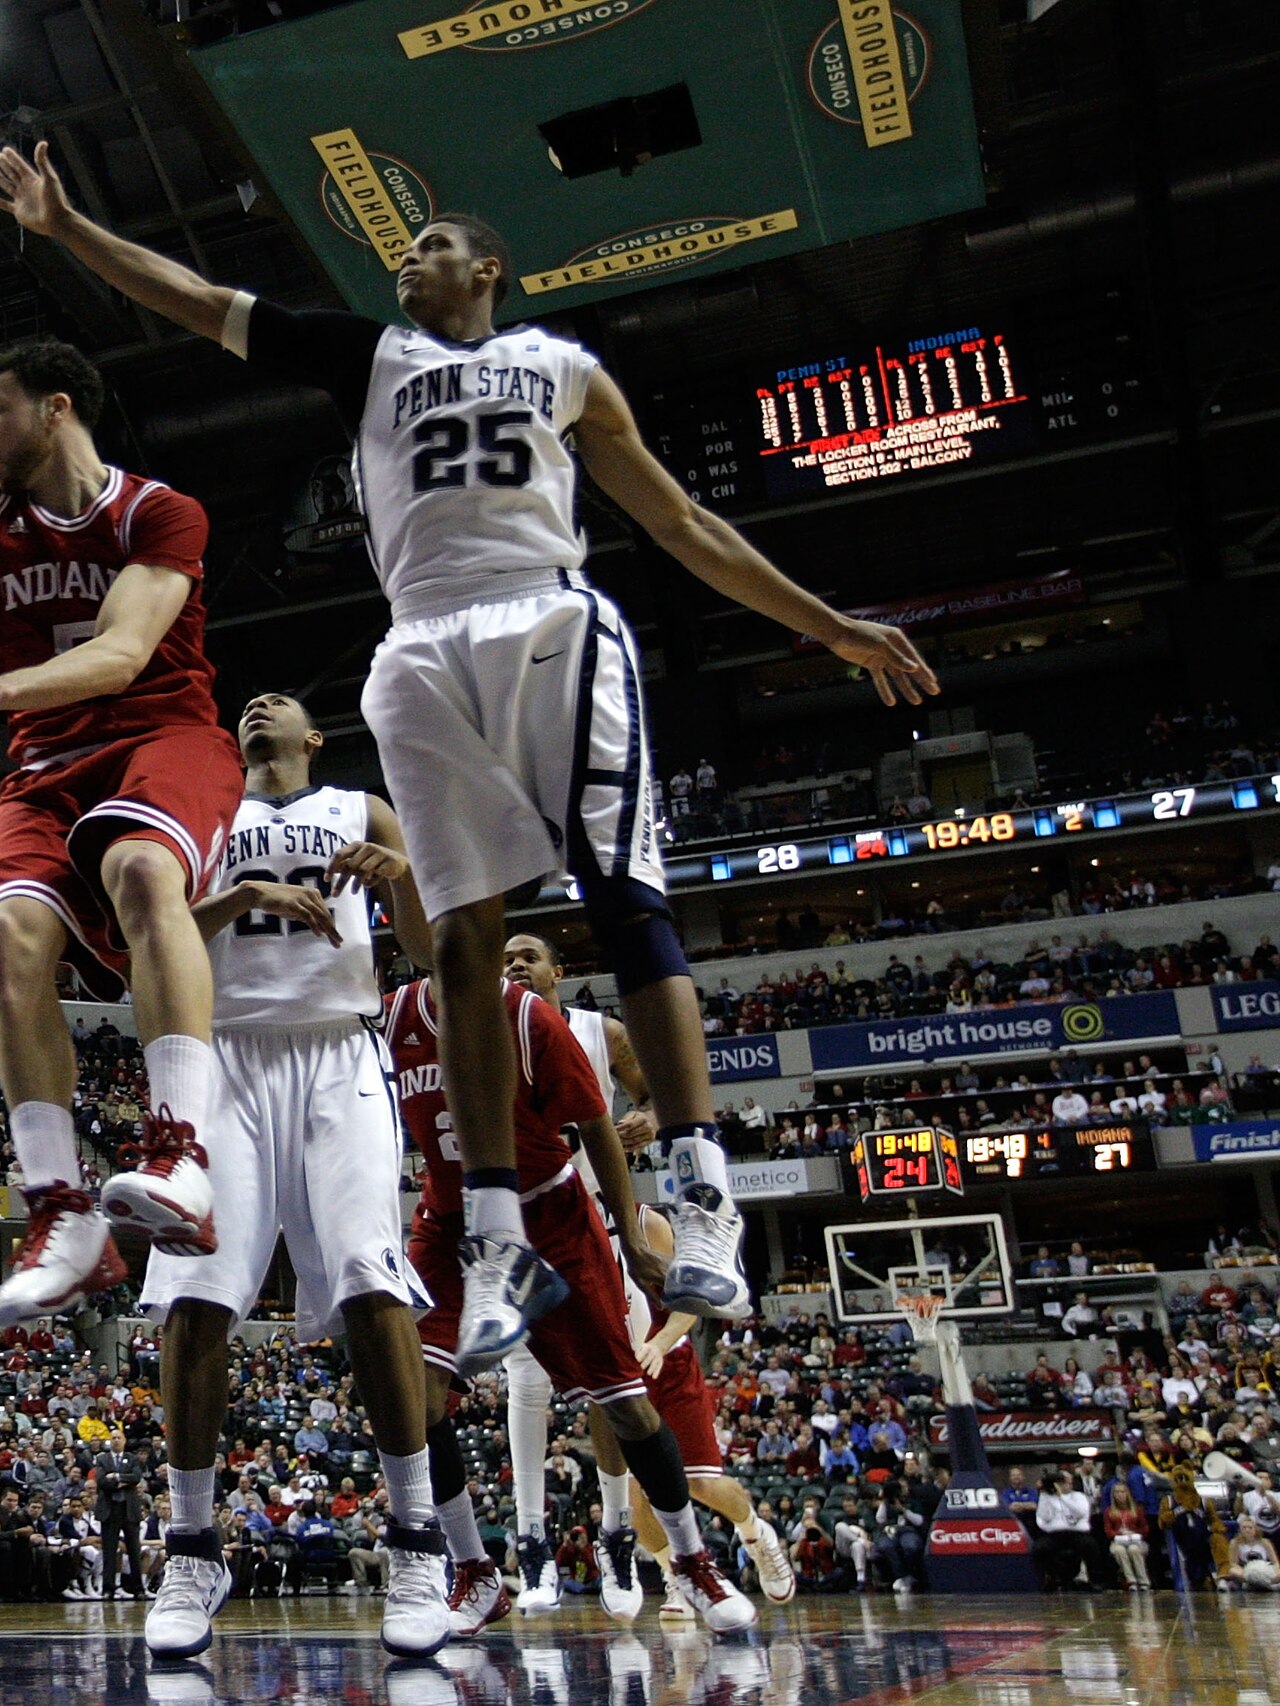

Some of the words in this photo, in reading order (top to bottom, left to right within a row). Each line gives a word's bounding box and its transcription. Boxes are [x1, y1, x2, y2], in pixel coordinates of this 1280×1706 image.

[505, 2, 629, 45] CONSECO
[822, 43, 850, 109] CONSECO
[325, 141, 405, 261] FIELDHOUSE
[383, 167, 424, 223] CONSECO
[540, 218, 777, 287] FIELDHOUSE
[596, 222, 705, 256] CONSECO
[908, 327, 980, 352] INDIANA
[777, 364, 820, 382] PENN
[826, 357, 846, 371] ST
[393, 364, 464, 429] PENN
[478, 366, 555, 421] STATE
[701, 421, 728, 436] DAL
[887, 418, 936, 437] ACROSS
[939, 411, 976, 427] FROM
[1047, 413, 1078, 430] ATL
[412, 411, 533, 496] 25
[705, 440, 734, 456] POR
[792, 454, 817, 468] THE
[819, 444, 868, 463] LOCKER
[871, 437, 908, 451] ROOM
[910, 416, 1000, 444] RESTAURANT,
[708, 460, 738, 478] WAS
[823, 457, 874, 474] SECTION
[895, 446, 925, 460] MAIN
[825, 467, 878, 486] SECTION
[880, 463, 901, 475] 202
[911, 448, 971, 469] BALCONY
[711, 483, 735, 499] CHI
[1041, 579, 1082, 600] BAR
[1151, 788, 1196, 820] 27
[921, 814, 1016, 849] 19:48
[1065, 811, 1083, 831] 2
[226, 826, 270, 870] ENN
[757, 844, 800, 873] 28
[856, 839, 887, 860] 24
[868, 1021, 956, 1053] bright
[960, 1018, 1052, 1043] house
[707, 1045, 773, 1072] ENDS
[876, 1131, 931, 1156] 19:48
[966, 1133, 1027, 1163] 19:48
[1037, 1132, 1051, 1149] 4
[1076, 1127, 1133, 1145] INDIANA
[1094, 1142, 1131, 1171] 27
[731, 1168, 799, 1188] inetico
[884, 1156, 927, 1188] 24
[930, 1529, 978, 1544] Great
[980, 1528, 1020, 1545] Clips
